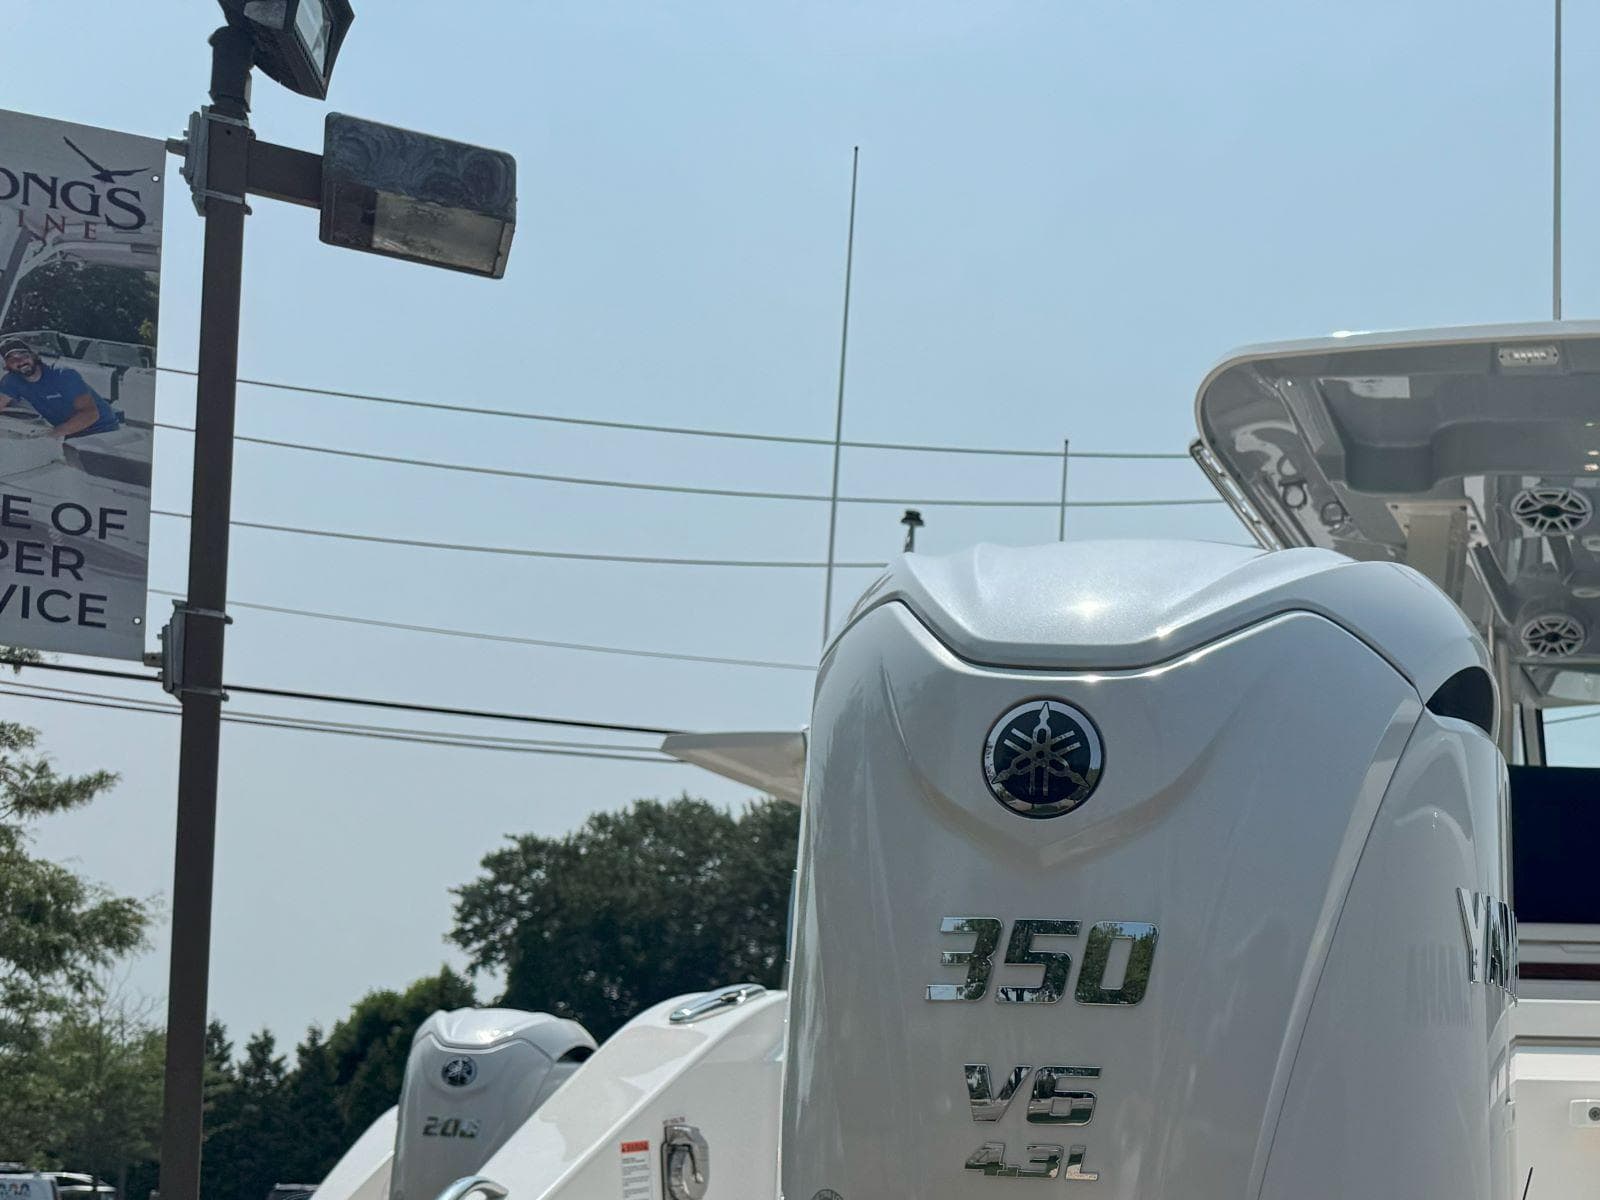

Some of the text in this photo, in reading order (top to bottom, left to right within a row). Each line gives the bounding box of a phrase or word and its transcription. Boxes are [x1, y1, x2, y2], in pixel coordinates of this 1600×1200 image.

[51, 502, 127, 540] OF
[925, 916, 1160, 1006] 350
[963, 1063, 1103, 1127] V6
[964, 1141, 1099, 1181] 4.3L
